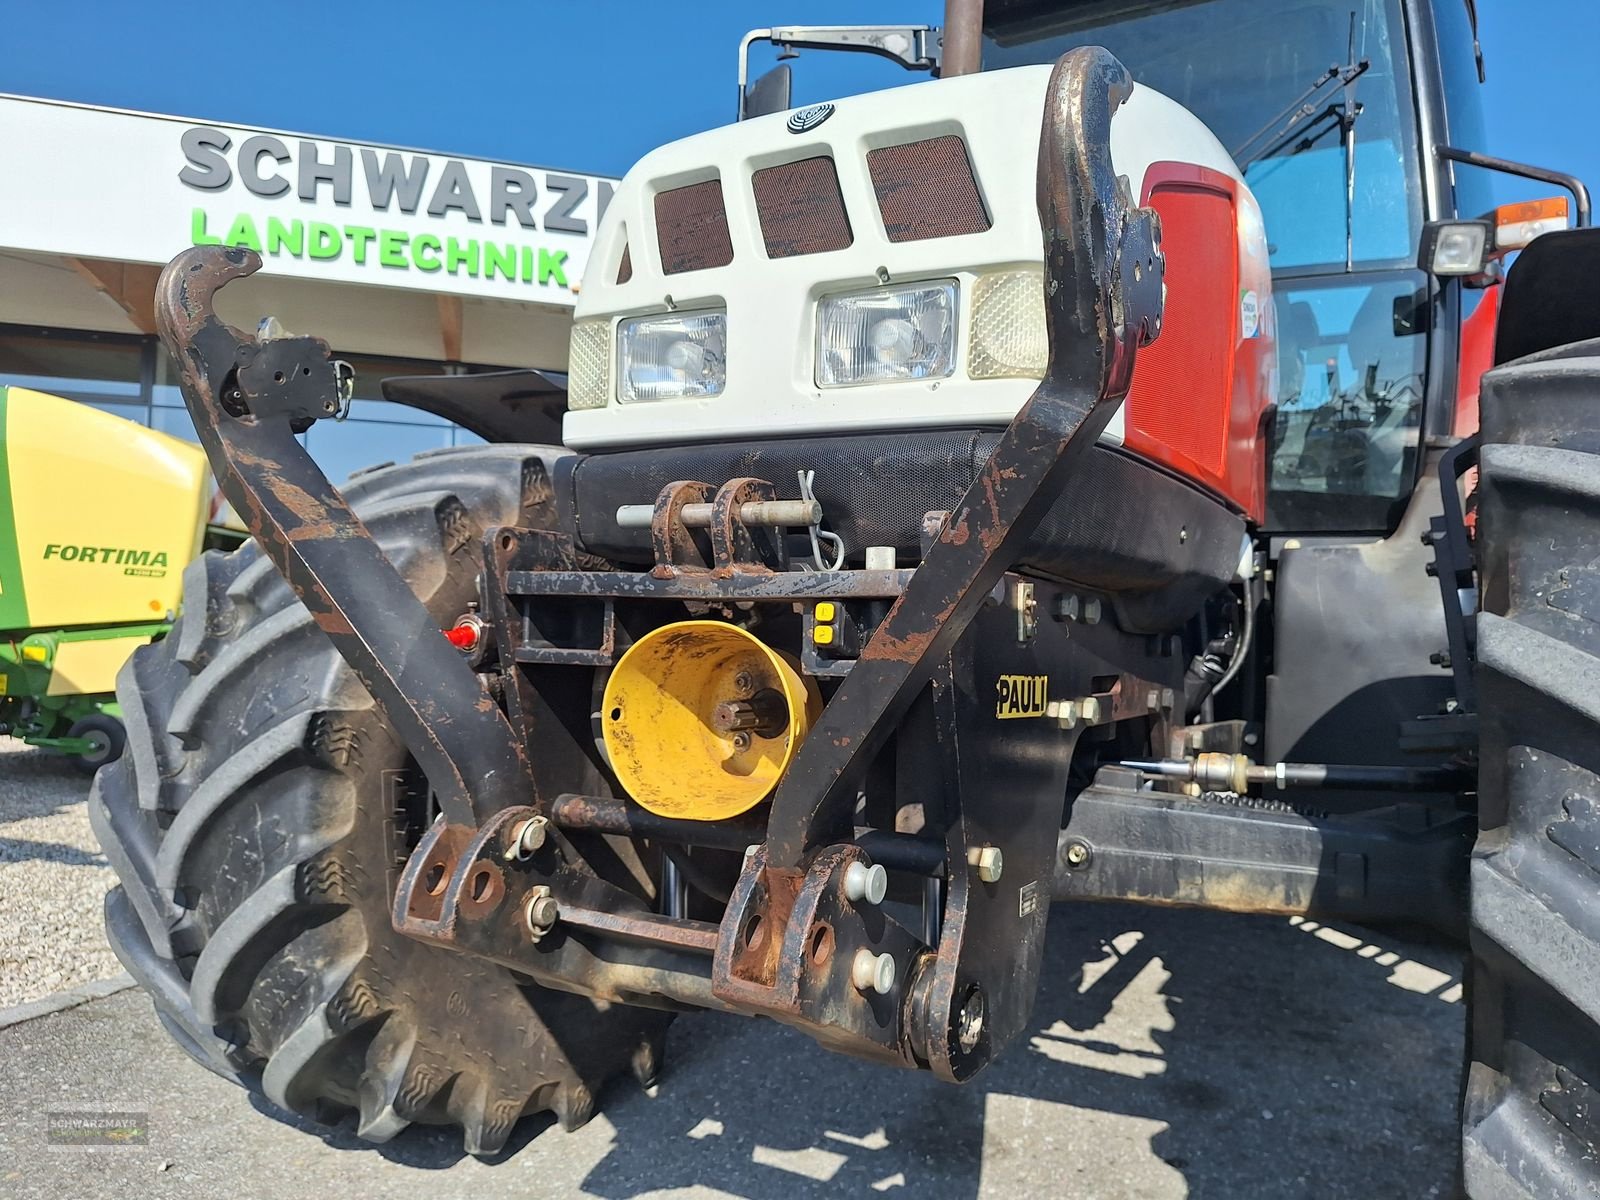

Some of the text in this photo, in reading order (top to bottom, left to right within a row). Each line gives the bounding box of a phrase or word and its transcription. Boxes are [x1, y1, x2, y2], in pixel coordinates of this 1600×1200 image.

[191, 208, 570, 288] LANDTECHNIK
[43, 544, 168, 567] FORTIMA
[998, 679, 1045, 714] PAULI
